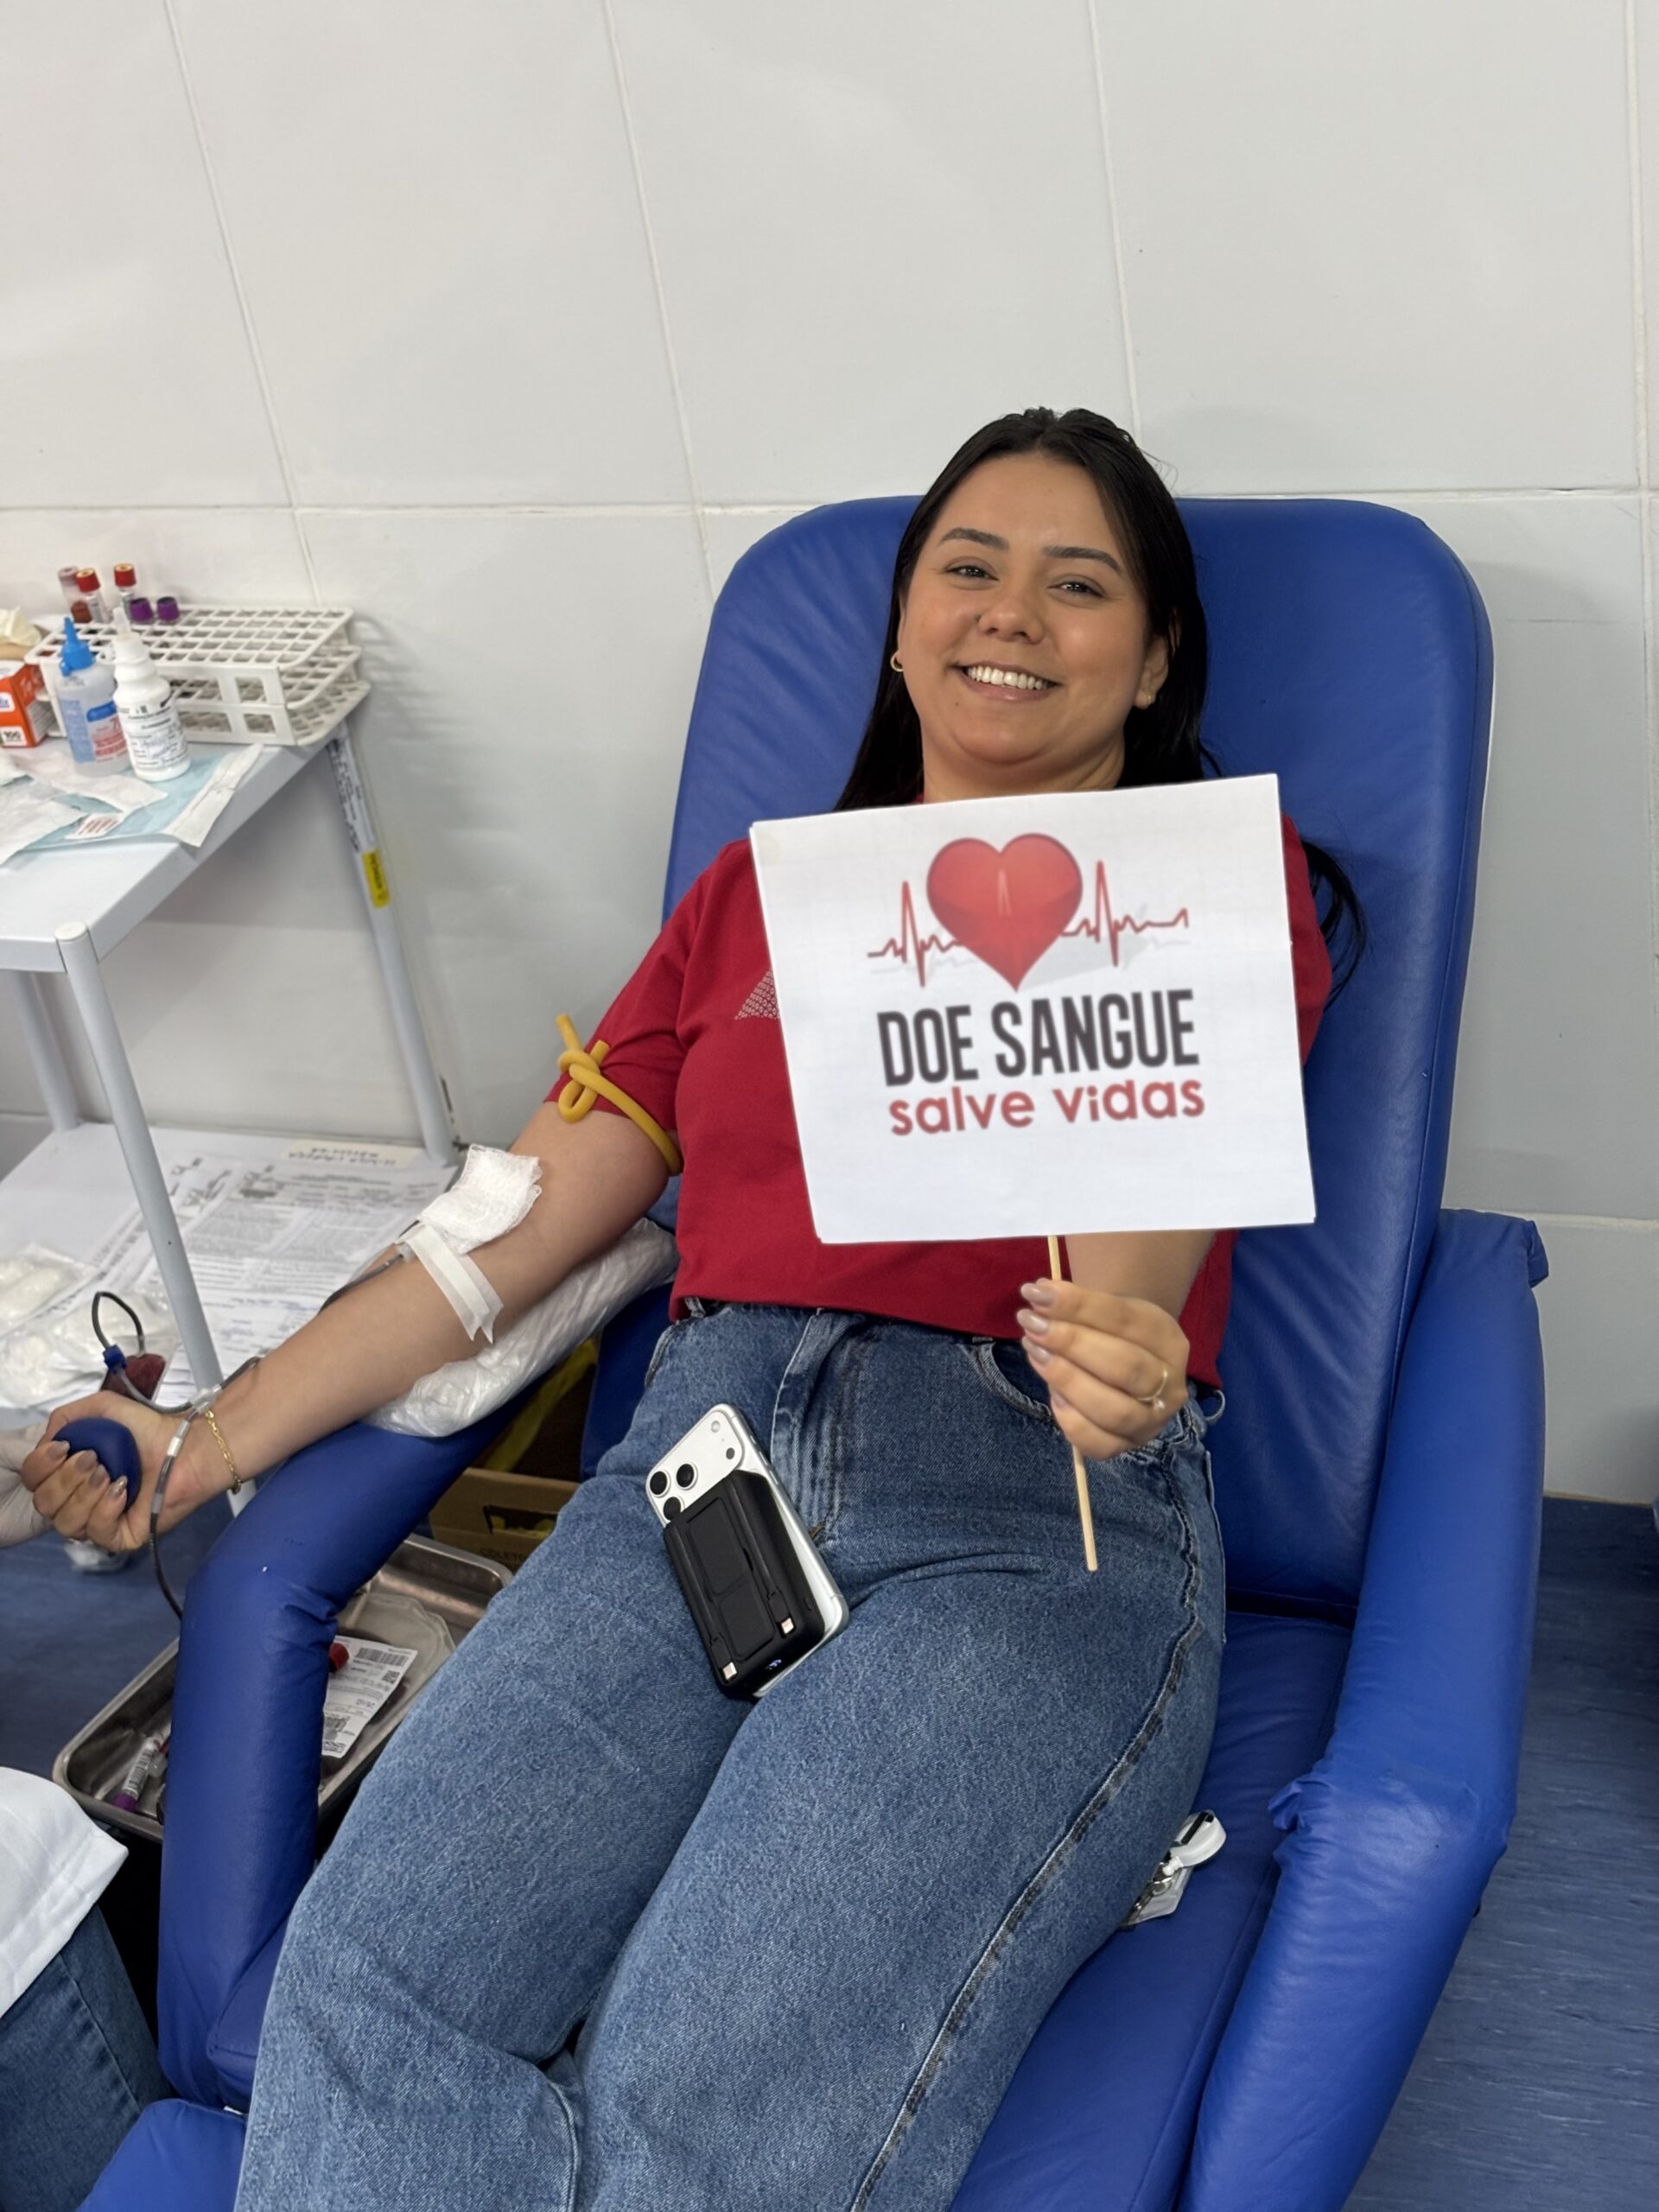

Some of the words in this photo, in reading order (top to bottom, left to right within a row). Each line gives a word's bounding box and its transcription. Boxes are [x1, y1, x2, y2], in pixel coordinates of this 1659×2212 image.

[876, 1004, 979, 1087] DOE
[990, 988, 1199, 1077] SANGUE
[889, 1086, 1034, 1136] salve
[1052, 1080, 1205, 1123] vidas
